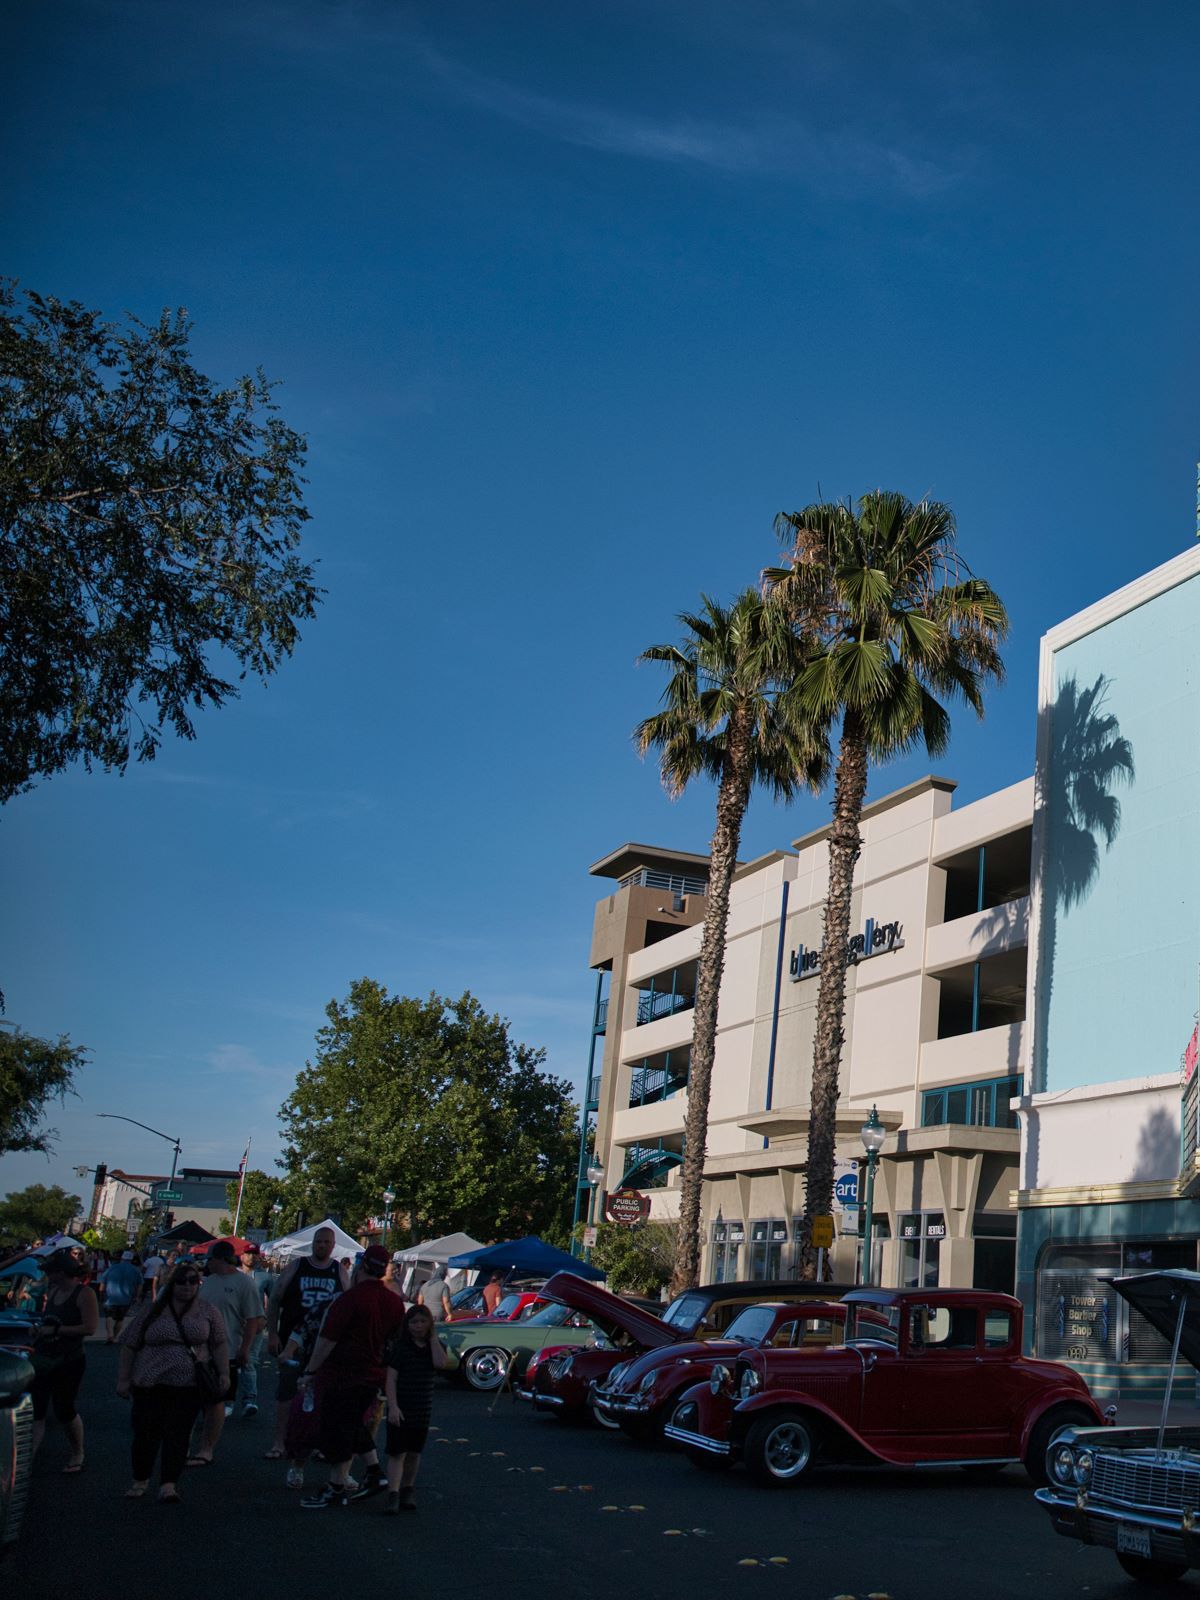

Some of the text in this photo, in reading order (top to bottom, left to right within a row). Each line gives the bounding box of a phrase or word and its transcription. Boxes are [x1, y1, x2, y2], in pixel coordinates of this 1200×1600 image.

[790, 918, 901, 977] blue gallery
[836, 1183, 857, 1196] art
[613, 1204, 640, 1212] PARKING
[616, 1198, 639, 1206] PUBLIC
[928, 1225, 945, 1236] RENTALS
[300, 1277, 337, 1293] KINGS
[1071, 1296, 1097, 1306] Tower
[1068, 1309, 1097, 1321] Barber
[1071, 1324, 1092, 1337] Shop
